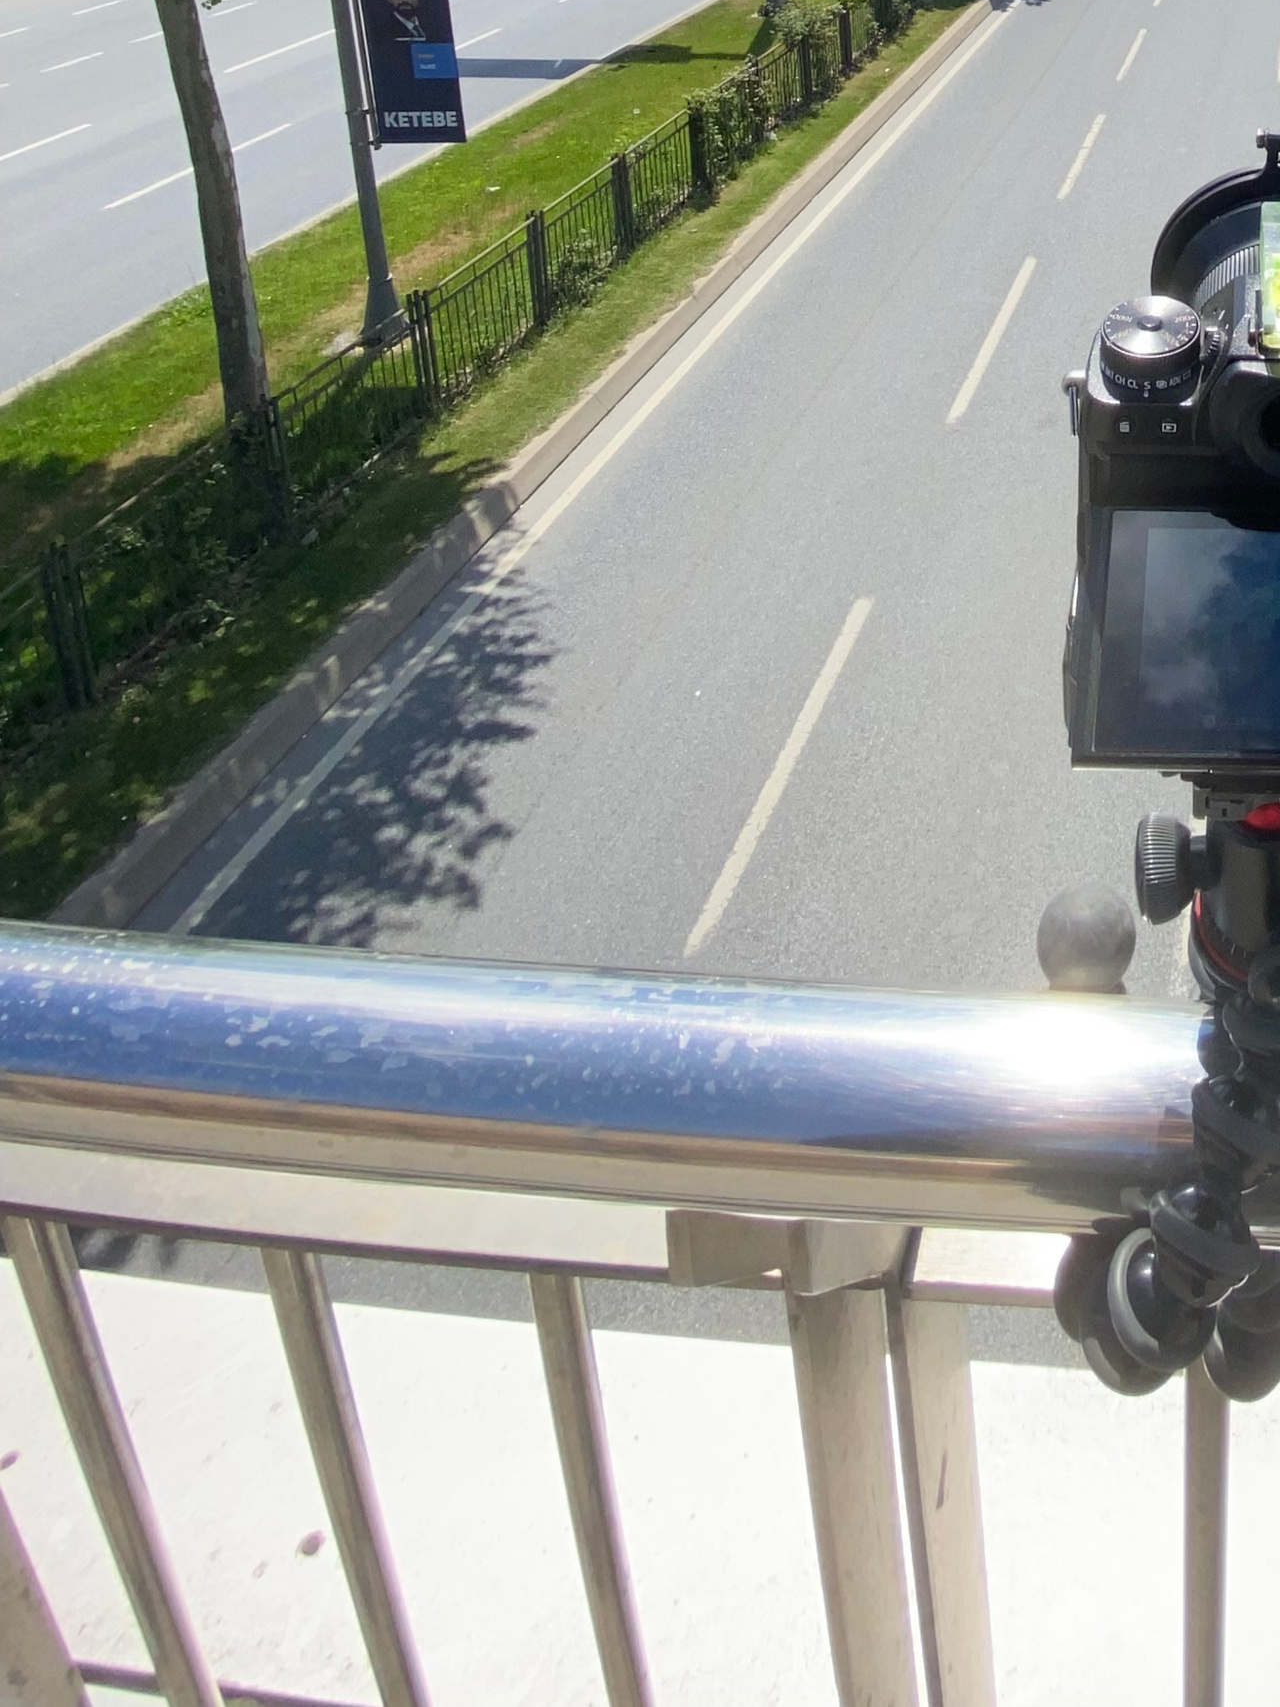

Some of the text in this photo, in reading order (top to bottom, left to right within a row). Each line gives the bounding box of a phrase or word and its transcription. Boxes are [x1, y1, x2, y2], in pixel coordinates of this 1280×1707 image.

[384, 111, 458, 128] KETEBE
[1127, 379, 1138, 389] CL
[1143, 381, 1151, 390] S
